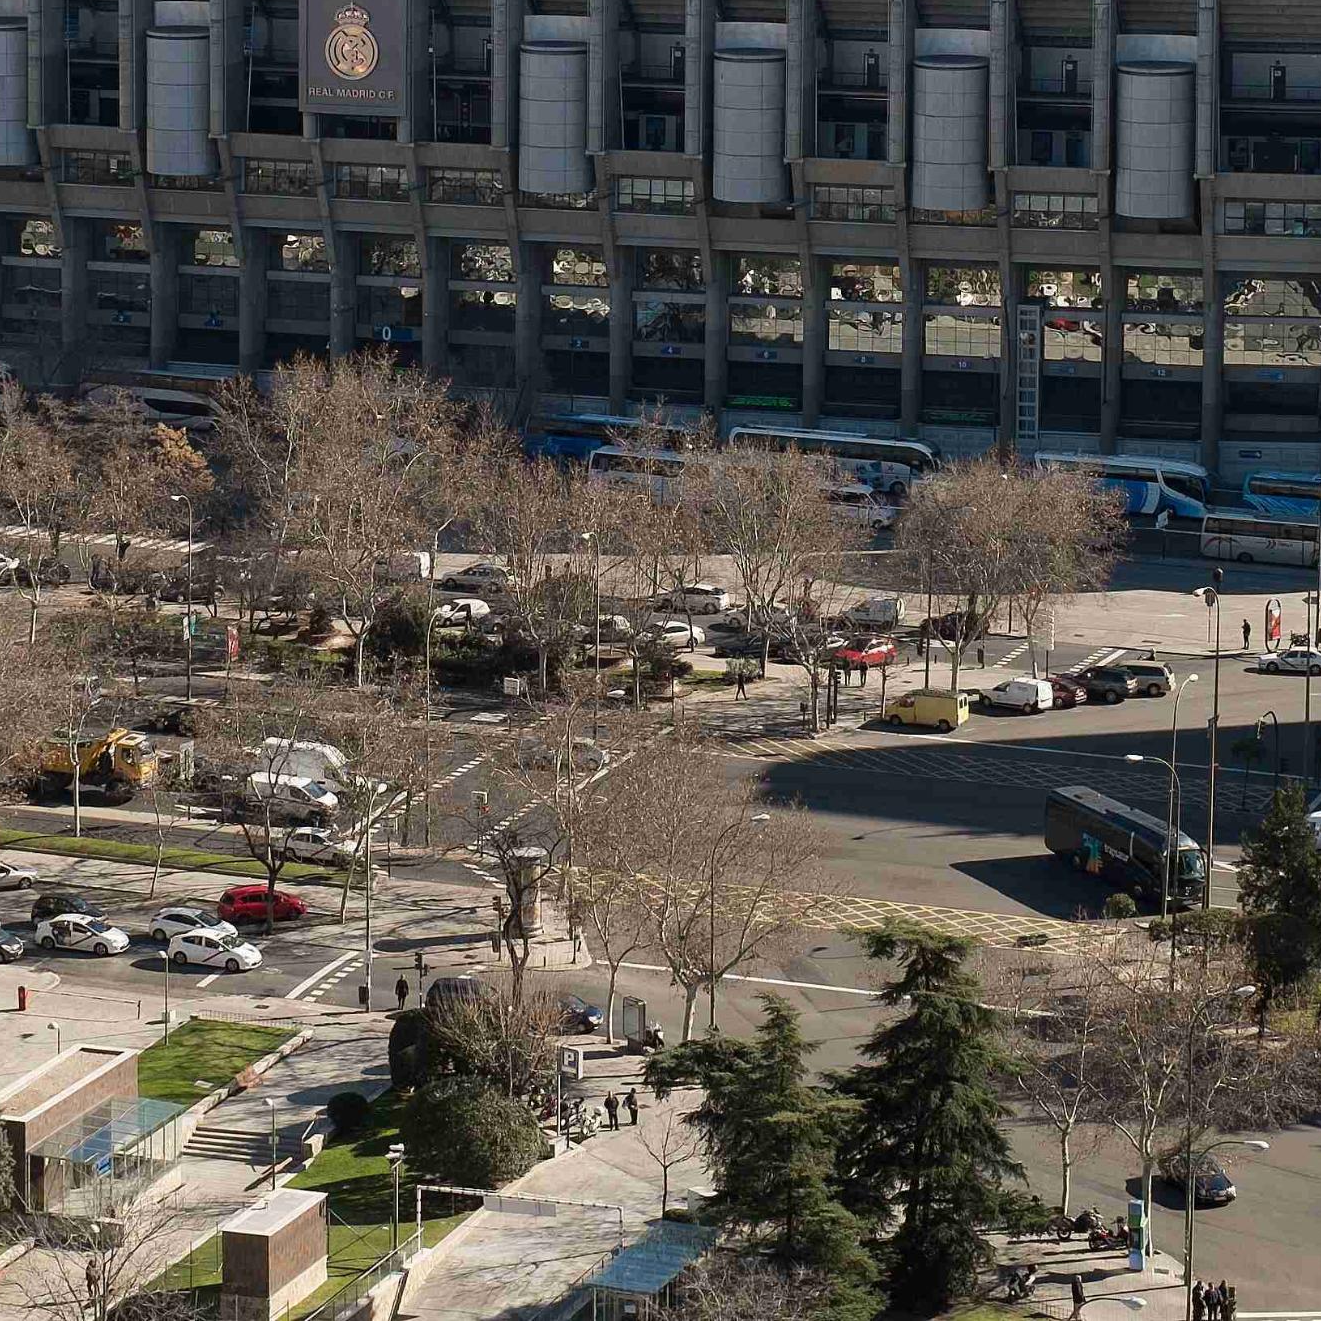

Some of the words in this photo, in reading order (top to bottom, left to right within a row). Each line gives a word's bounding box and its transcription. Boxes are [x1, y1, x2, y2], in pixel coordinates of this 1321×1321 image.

[309, 87, 334, 97] REAL
[336, 88, 376, 98] MADRID
[564, 1050, 574, 1066] P
